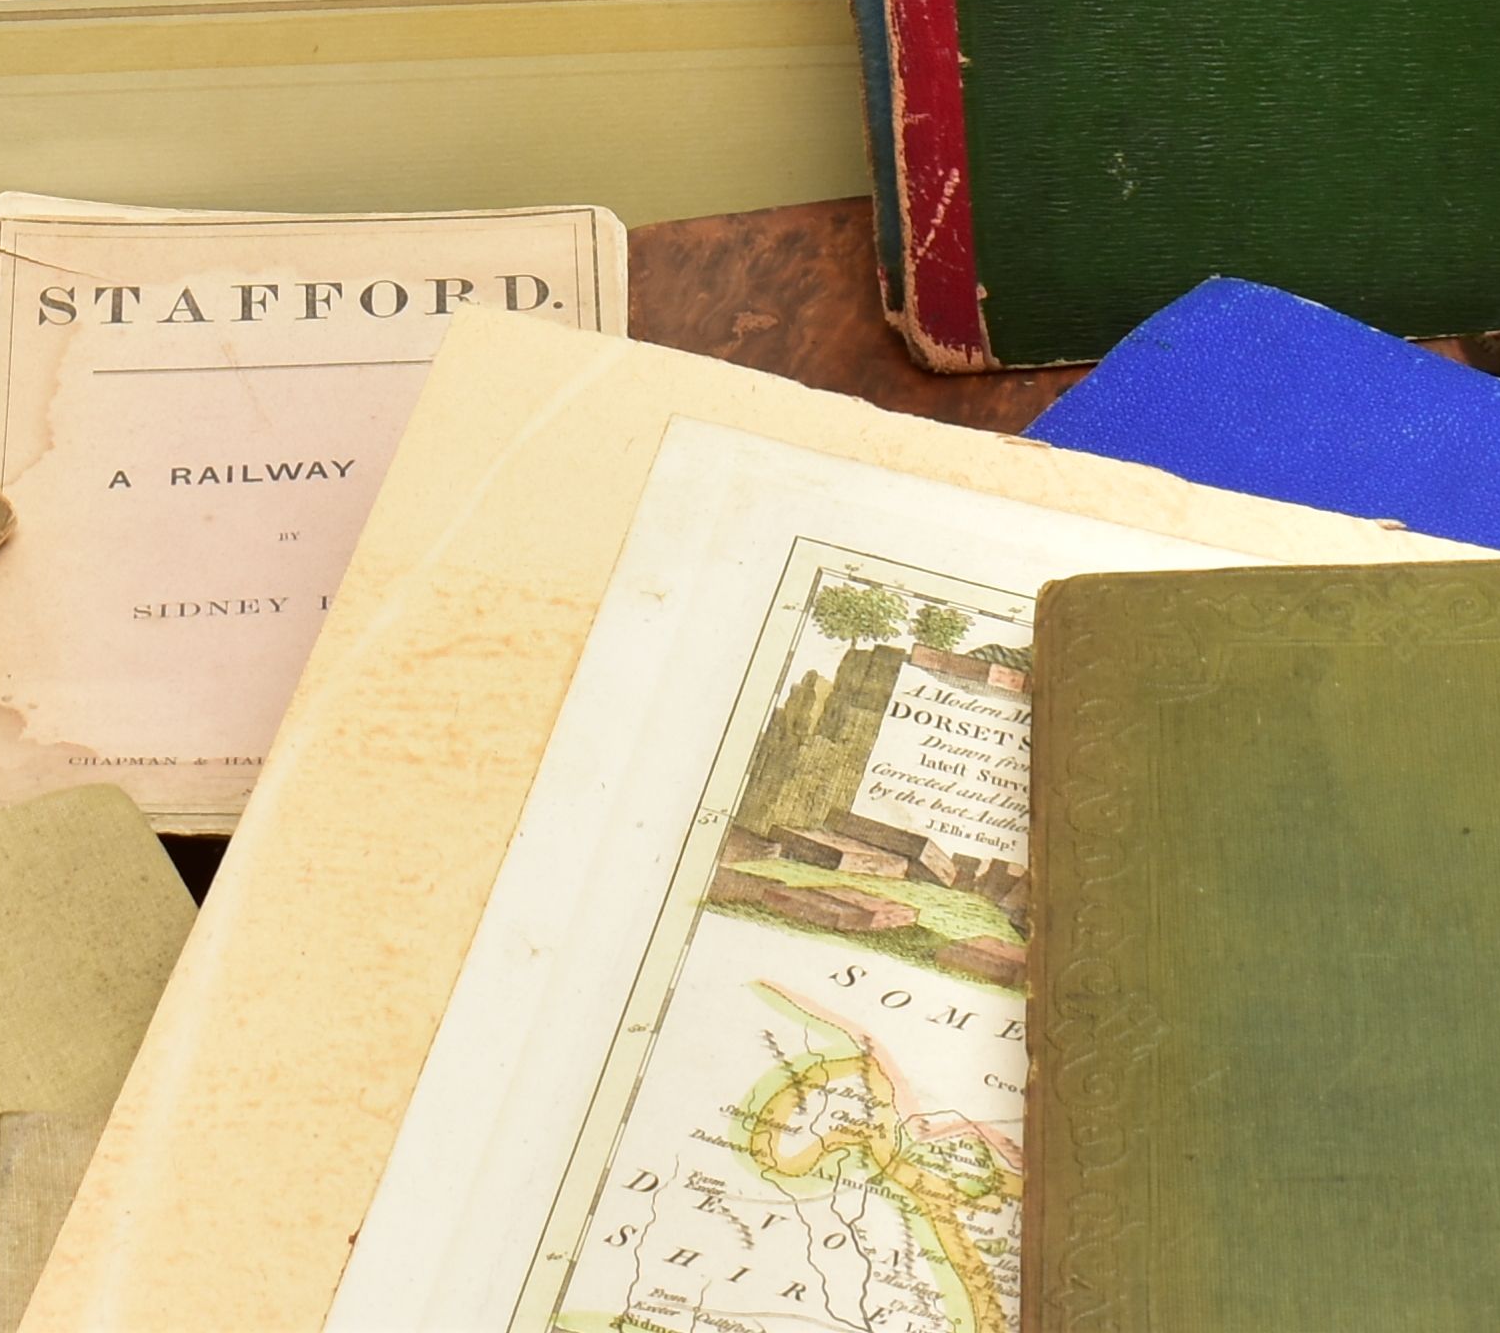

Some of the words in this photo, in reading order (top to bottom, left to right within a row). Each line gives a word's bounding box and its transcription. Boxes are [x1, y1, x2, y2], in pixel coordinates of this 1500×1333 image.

[38, 274, 565, 326] STAFFORD.
[108, 471, 132, 488] A
[171, 459, 357, 486] RAILWAY
[278, 532, 300, 541] BY
[133, 597, 288, 620] SIDNEY
[931, 686, 1002, 719] Modern
[889, 700, 1014, 746] DORSET
[68, 756, 178, 766] CHAPMAN
[193, 757, 208, 765] &
[920, 735, 990, 764] Drawn
[869, 781, 892, 800] by
[896, 783, 925, 807] the
[930, 796, 969, 820] best
[872, 762, 954, 795] Corrected
[955, 783, 997, 808] and
